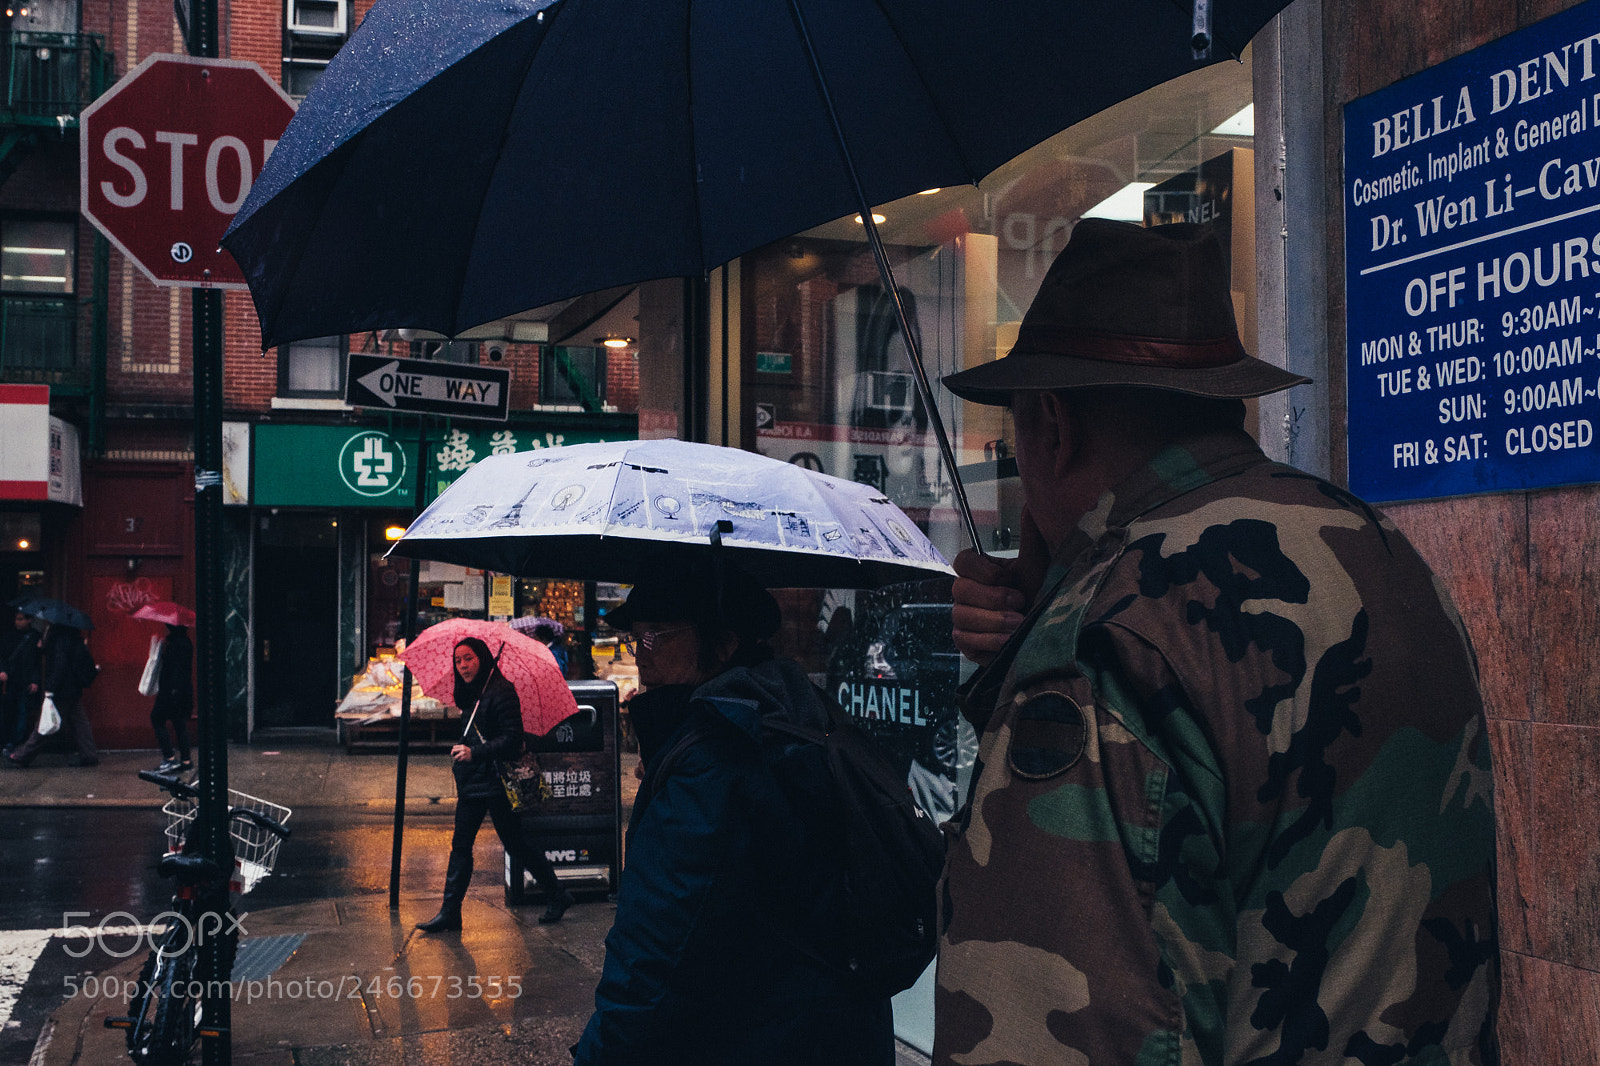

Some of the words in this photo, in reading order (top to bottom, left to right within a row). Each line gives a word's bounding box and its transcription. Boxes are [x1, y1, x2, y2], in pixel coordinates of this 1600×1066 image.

[1372, 85, 1476, 159] BELLA
[1490, 33, 1600, 115] DENT
[100, 126, 280, 215] STO
[1353, 161, 1423, 207] Cosmetic.
[1428, 136, 1490, 182] Implant
[1495, 127, 1509, 159] &
[1514, 98, 1587, 152] General
[1180, 199, 1220, 224] NEL
[1370, 214, 1407, 252] Dr.
[1414, 195, 1478, 237] Wen
[1405, 266, 1466, 317] OFF
[1361, 334, 1403, 366] MON
[1408, 330, 1423, 356] &
[1426, 318, 1485, 352] THUR:
[379, 372, 423, 397] ONE
[445, 378, 492, 403] WAY
[1377, 368, 1411, 398] TUE
[1417, 365, 1431, 391] &
[1436, 356, 1486, 387] WED:
[1438, 393, 1487, 424] SUN:
[1504, 377, 1600, 415] 9:00AM~
[1393, 441, 1419, 469] FRI
[1424, 439, 1439, 465] &
[1444, 433, 1488, 462] SAT:
[1505, 419, 1593, 456] CLOSED
[837, 681, 927, 727] CHANEL
[544, 849, 577, 862] NYC
